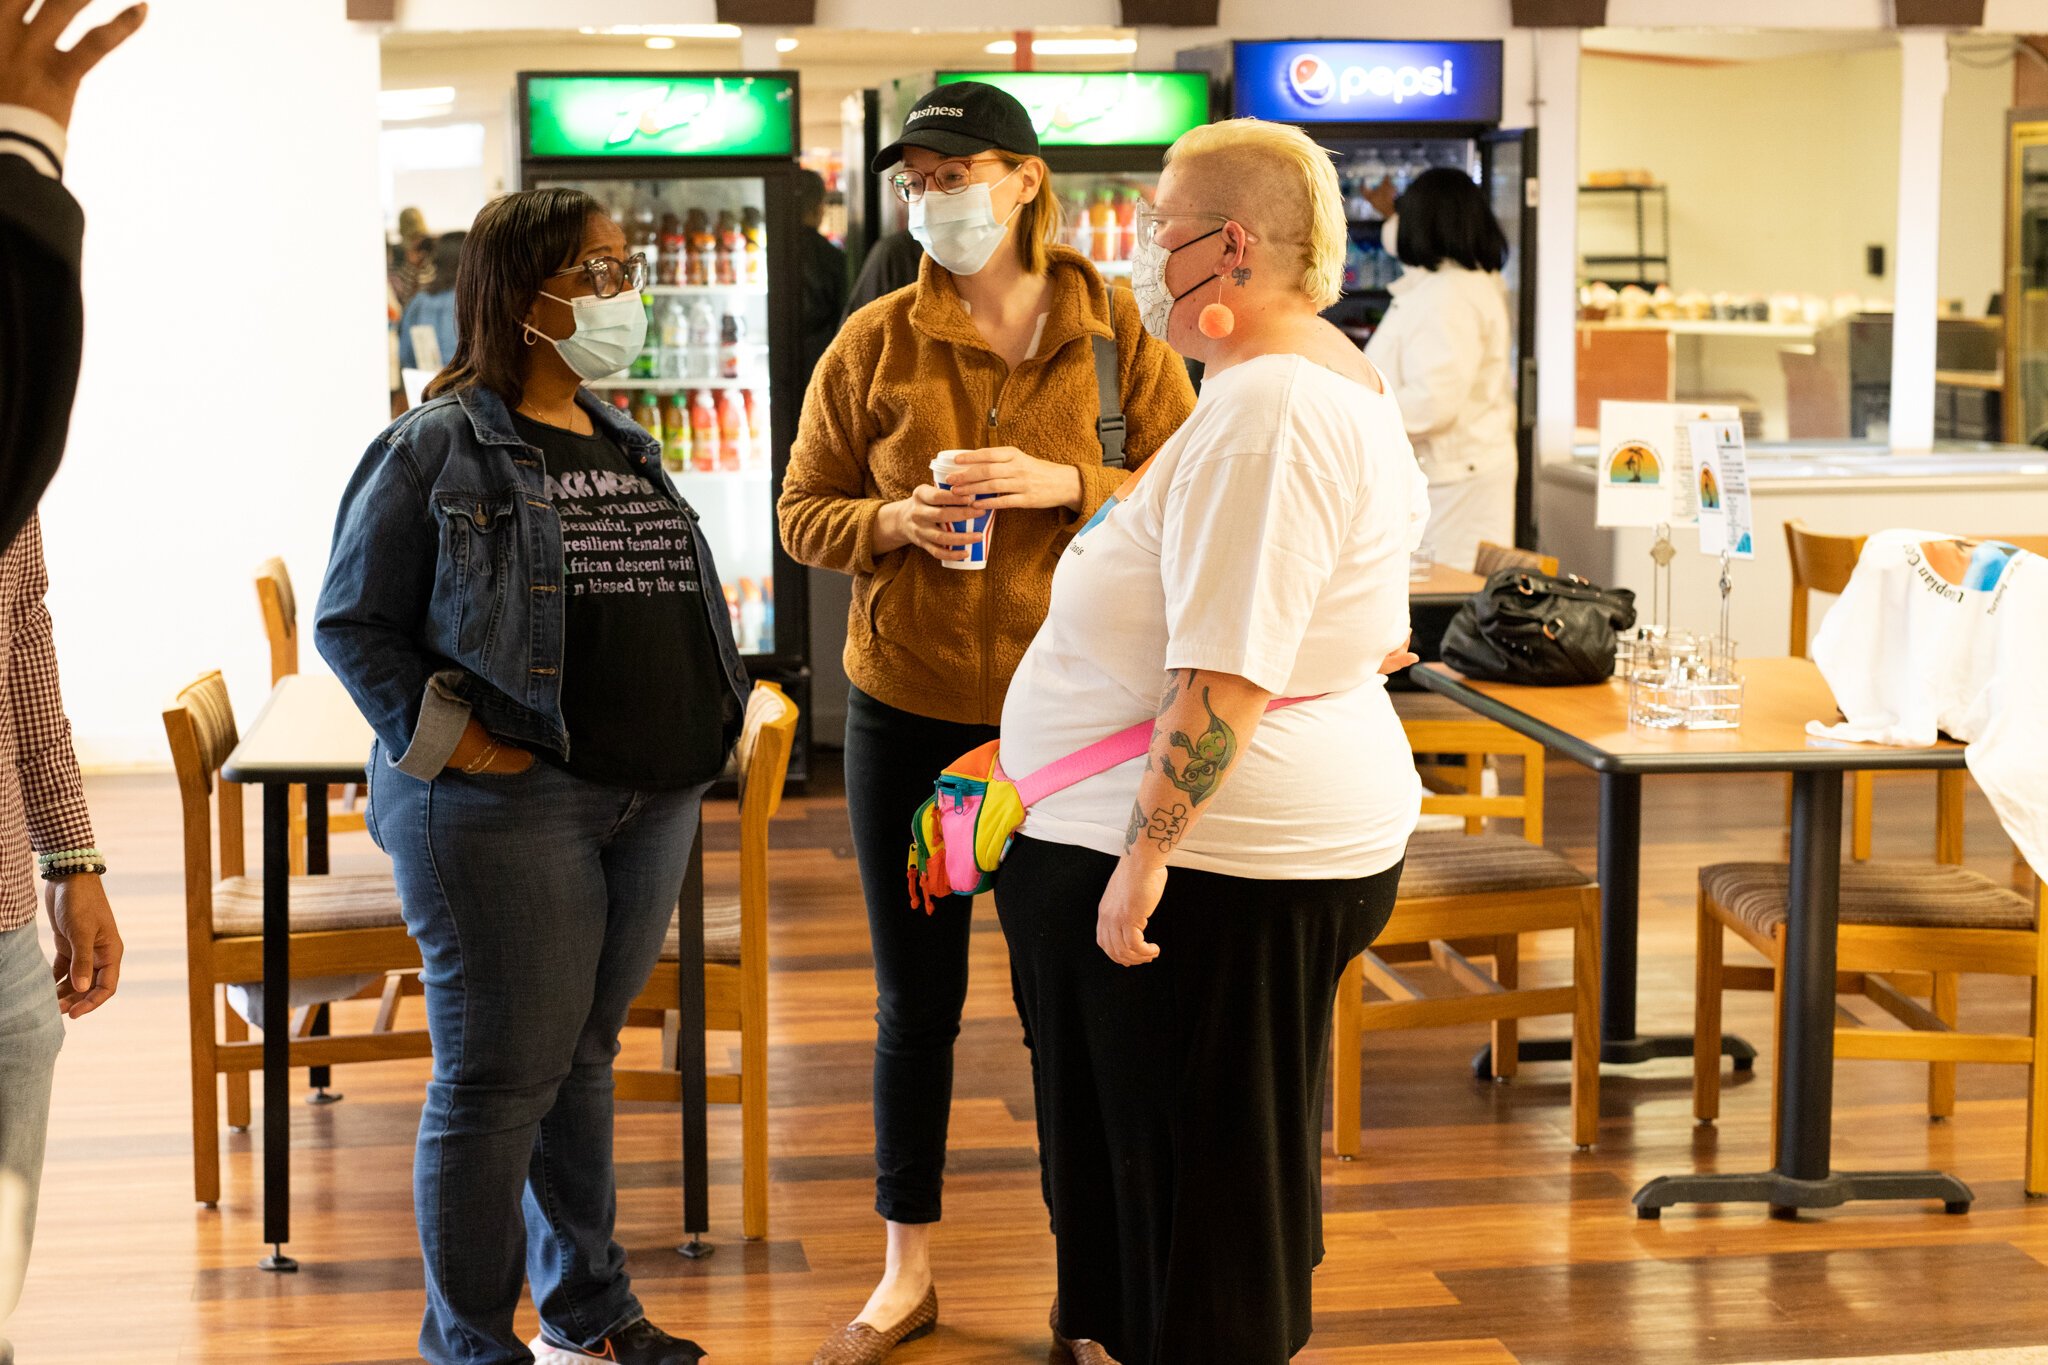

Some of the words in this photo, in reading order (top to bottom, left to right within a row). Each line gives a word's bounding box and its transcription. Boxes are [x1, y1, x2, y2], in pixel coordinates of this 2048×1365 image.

[1340, 59, 1453, 104] pepsi
[545, 471, 594, 501] ACK
[564, 535, 625, 553] resilient
[626, 535, 672, 552] female
[674, 534, 688, 551] of
[615, 556, 666, 573] descent
[589, 577, 636, 595] kissed
[637, 577, 654, 597] by
[657, 576, 676, 593] the
